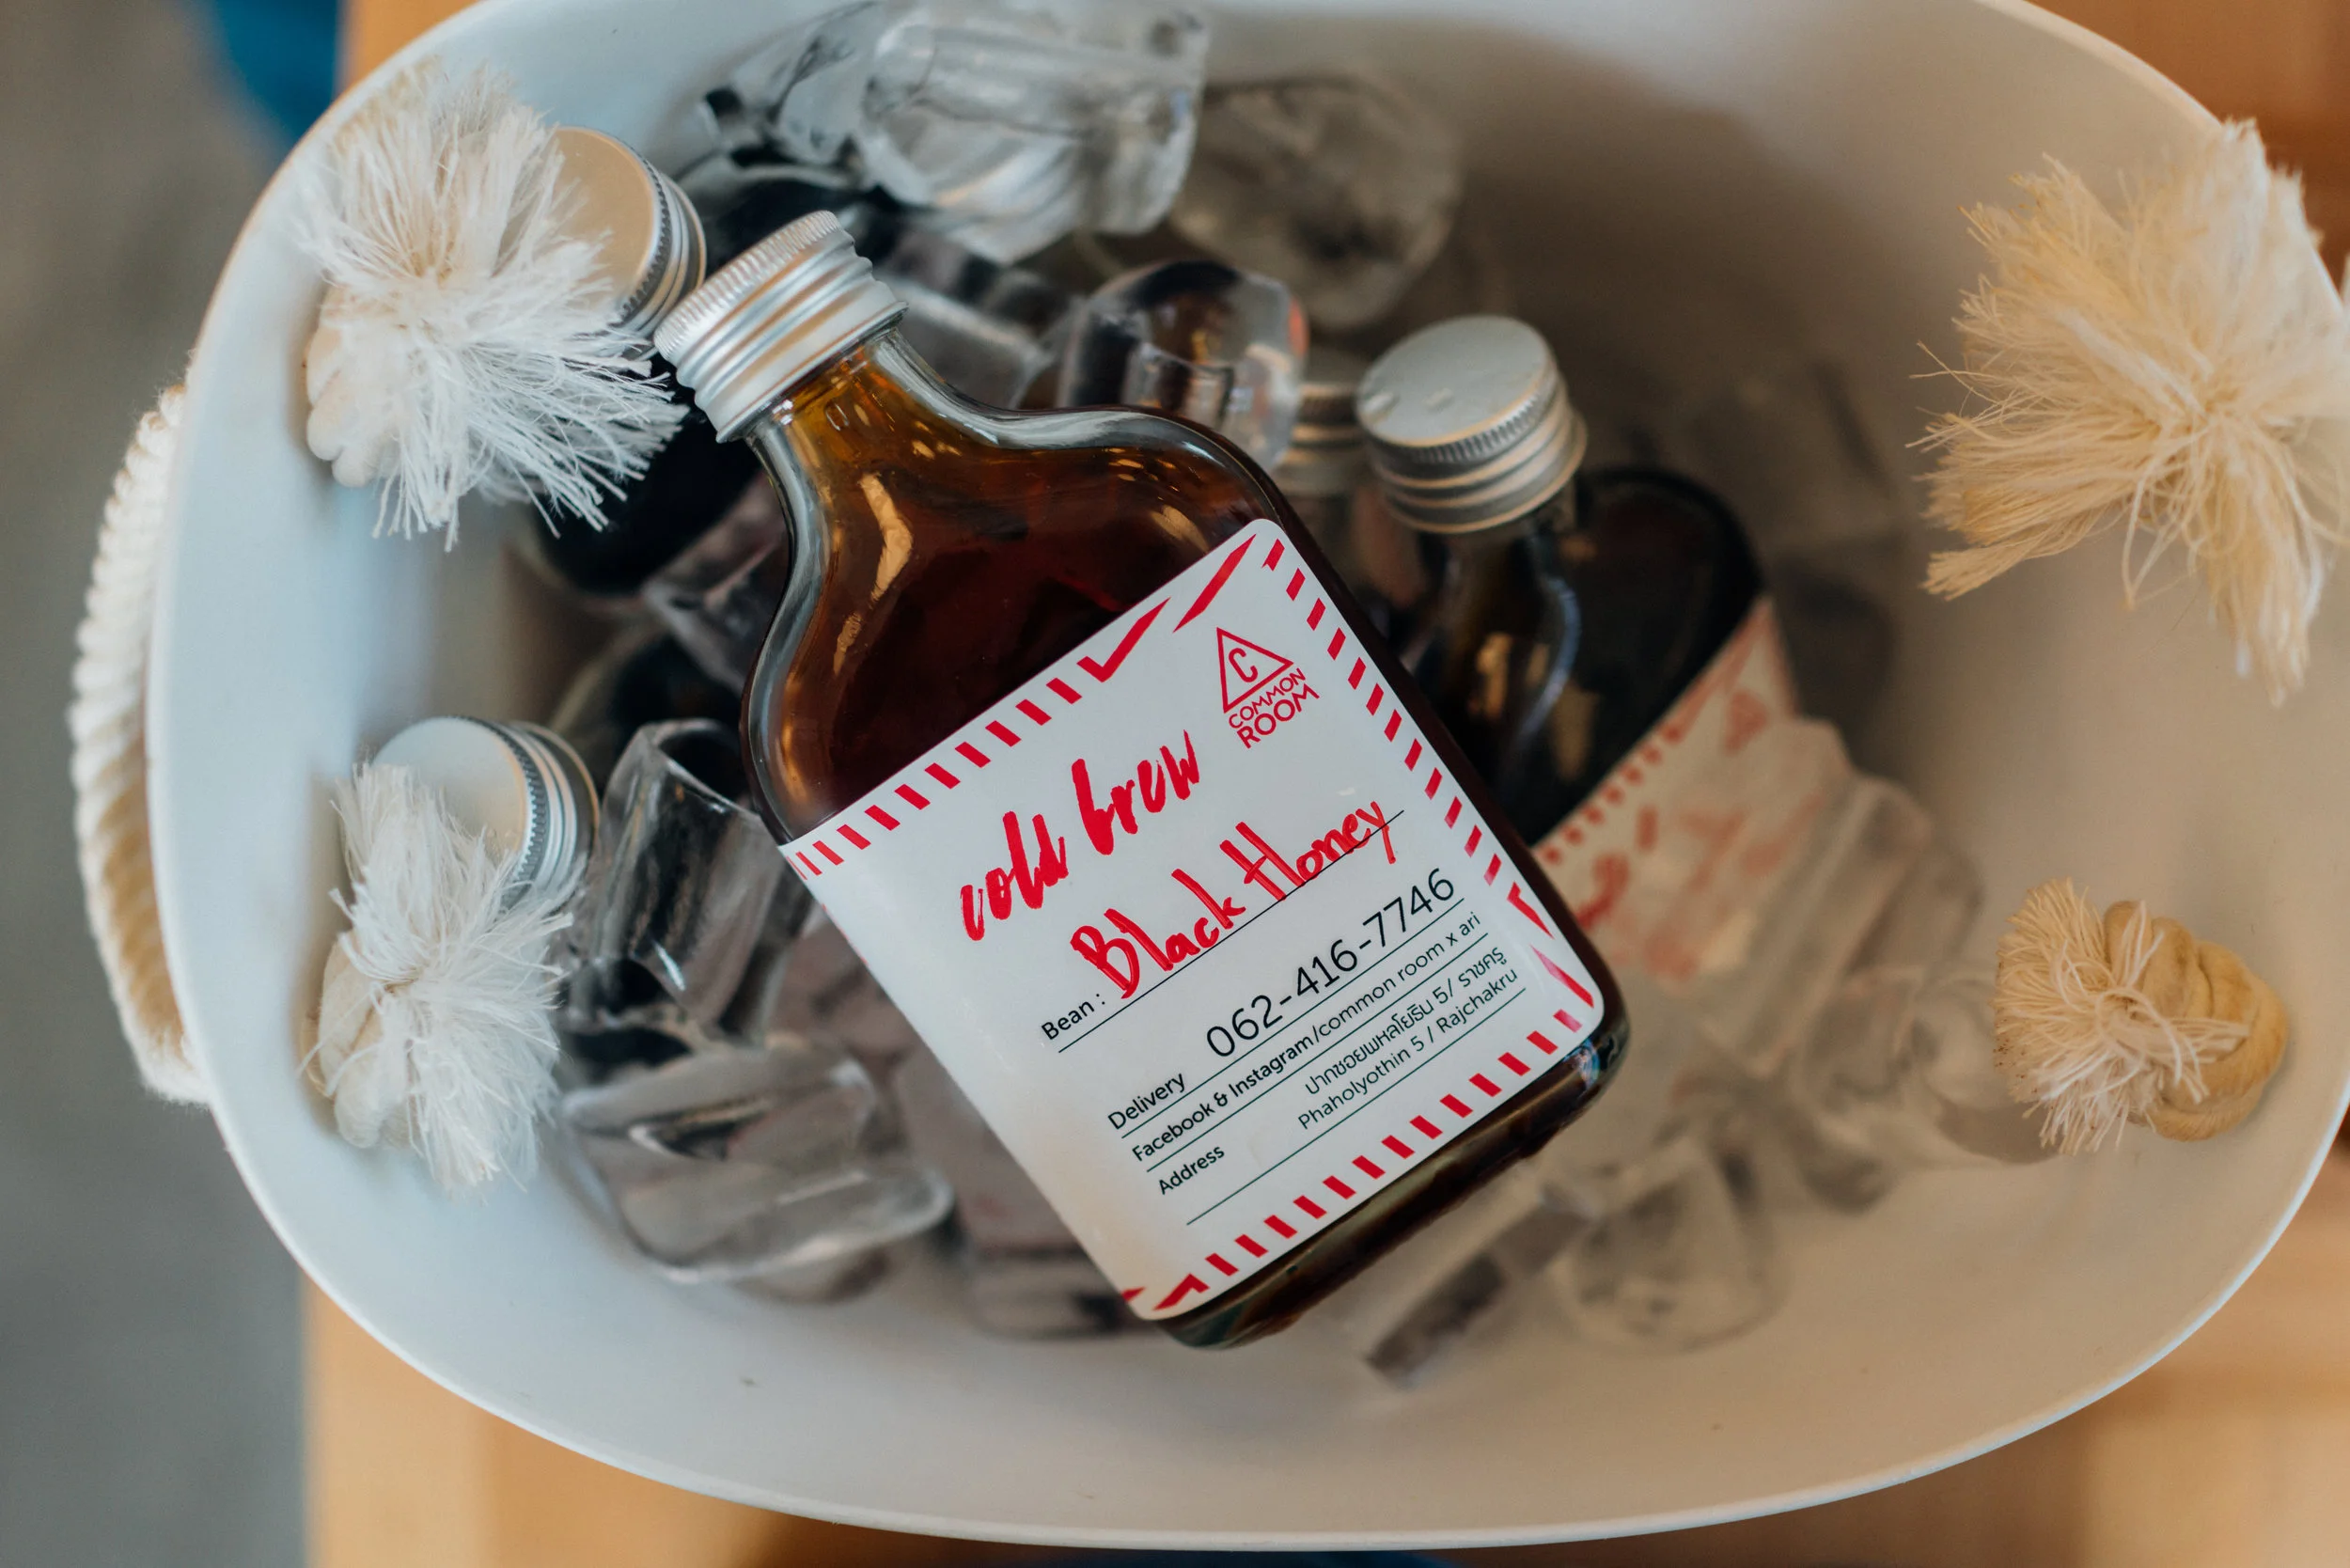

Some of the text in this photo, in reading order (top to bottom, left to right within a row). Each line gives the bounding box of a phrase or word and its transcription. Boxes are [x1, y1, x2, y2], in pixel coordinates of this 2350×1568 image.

[1229, 667, 1306, 729] COMMON
[1237, 683, 1320, 749] ROOM
[960, 729, 1199, 940] cold brew
[1071, 801, 1396, 998] Black Honey
[1207, 868, 1454, 1057] 062-416-7746
[1042, 1001, 1095, 1040] Bean
[1132, 1104, 1215, 1161] Facebook
[1214, 1091, 1229, 1107] &
[1397, 943, 1445, 981] room
[1446, 933, 1458, 946] x
[1459, 912, 1480, 936] ari
[1298, 1048, 1411, 1129] Phaholyothin
[1410, 1035, 1425, 1051] 5
[1435, 969, 1518, 1034] Rajchakru
[1107, 1074, 1185, 1130] Delivery
[1159, 1145, 1225, 1195] Address
